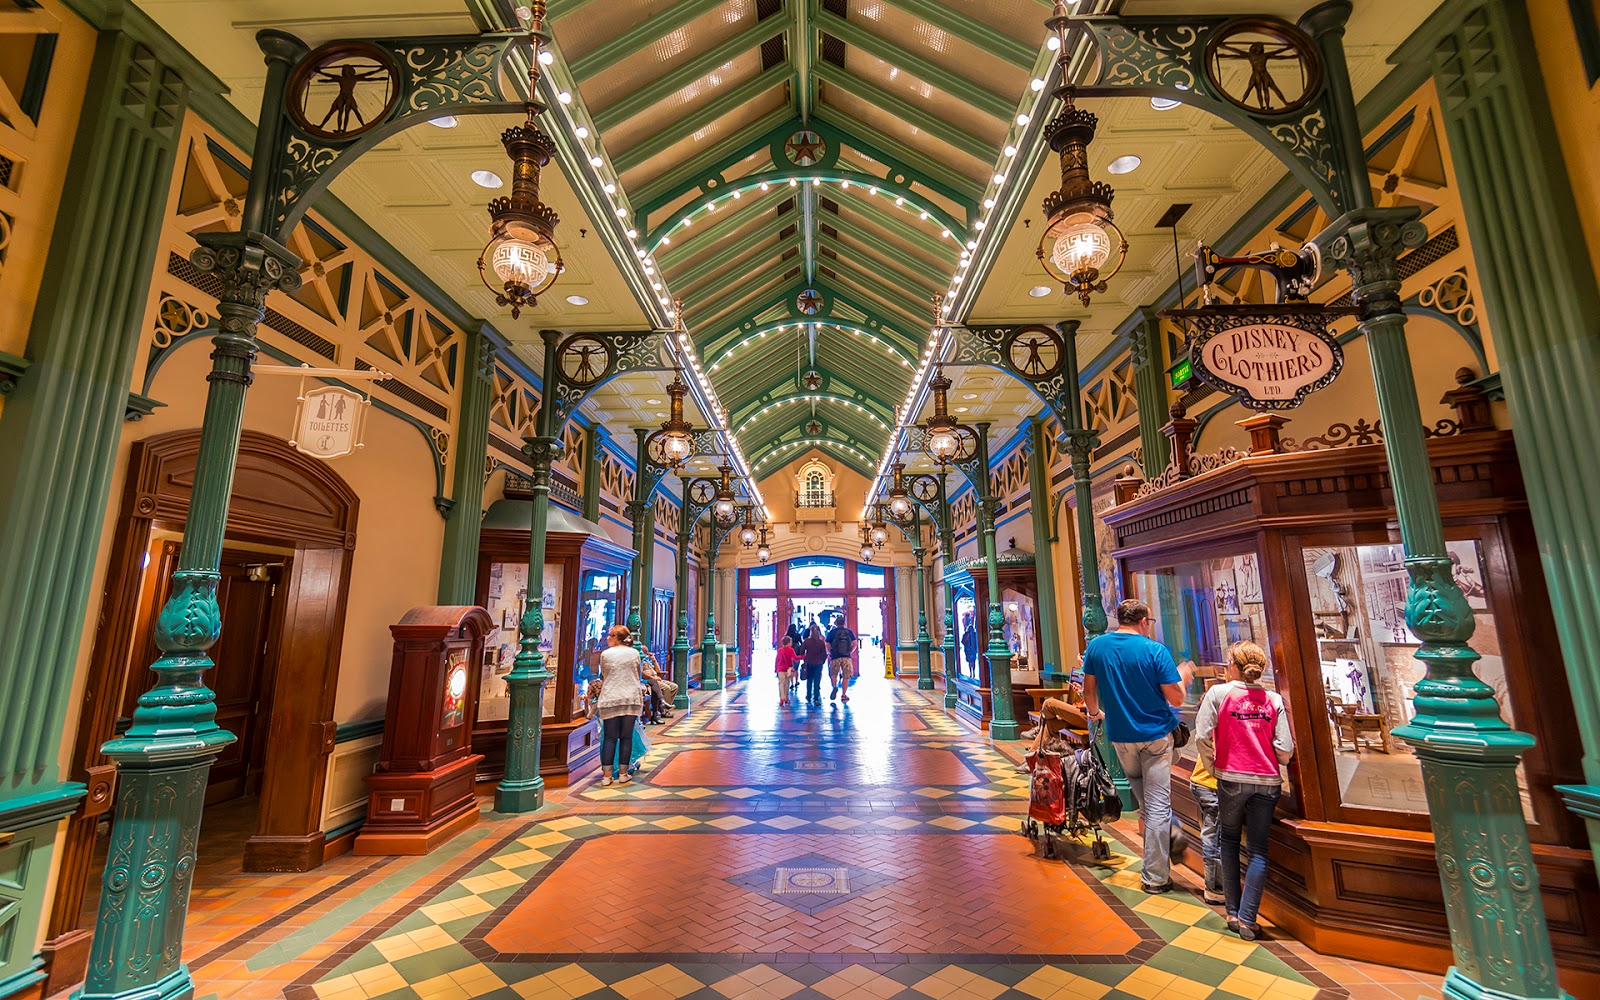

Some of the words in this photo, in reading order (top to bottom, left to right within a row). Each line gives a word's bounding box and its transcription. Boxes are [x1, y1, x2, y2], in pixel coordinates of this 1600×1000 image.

[1231, 328, 1299, 354] DISNEY
[1212, 341, 1322, 382] CLOTHIERS
[1263, 385, 1283, 395] LTD.
[309, 421, 348, 432] TOILETTES
